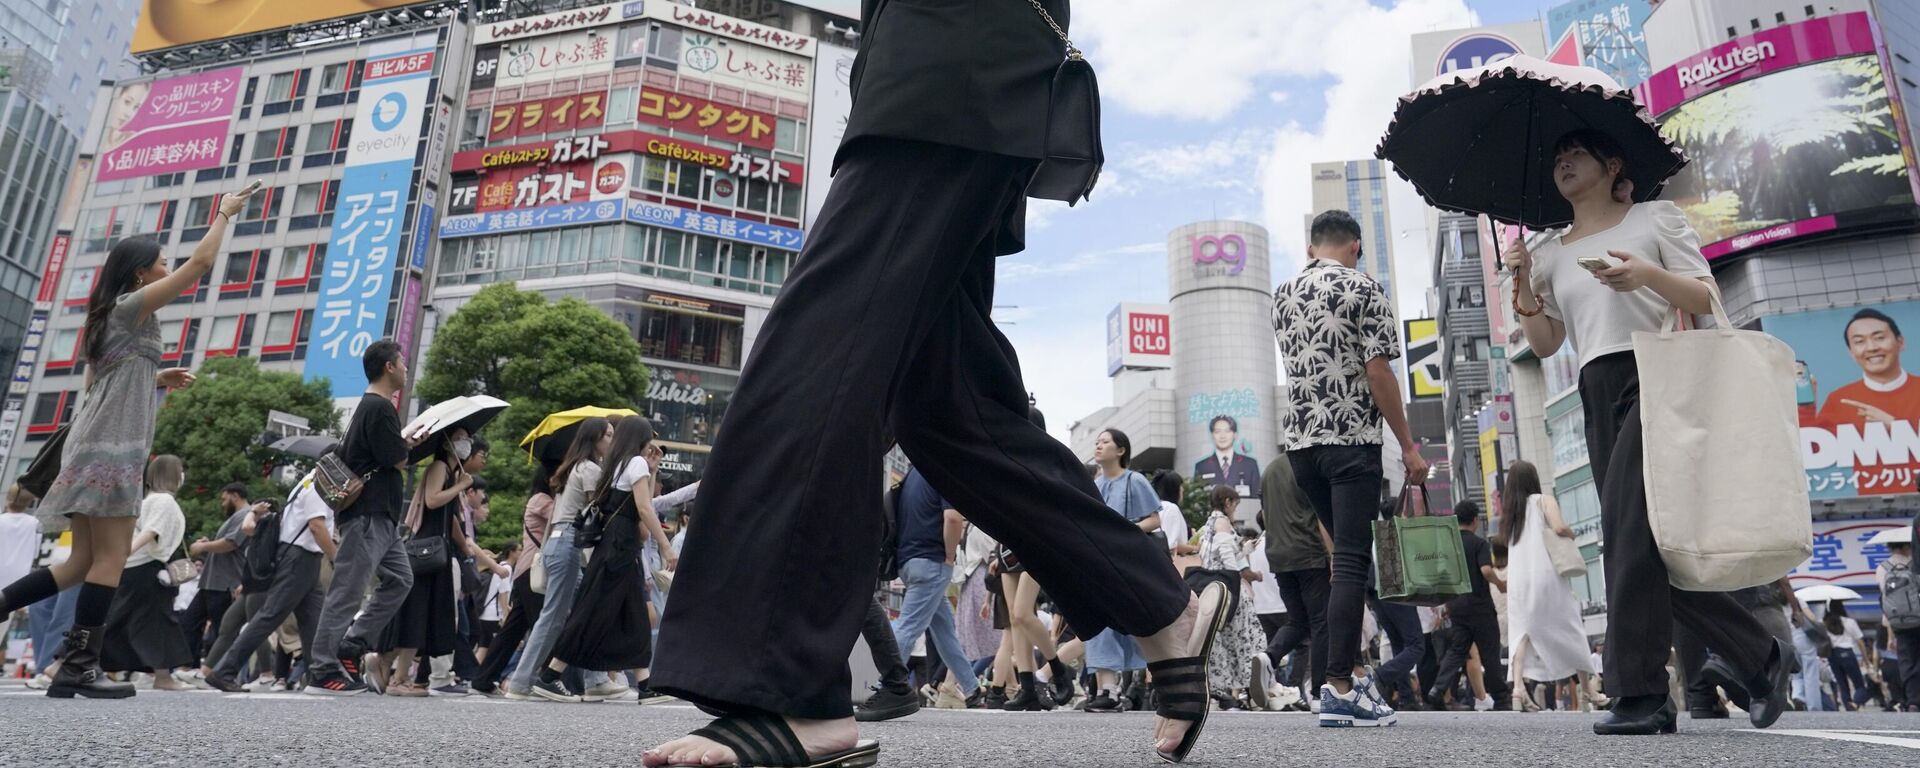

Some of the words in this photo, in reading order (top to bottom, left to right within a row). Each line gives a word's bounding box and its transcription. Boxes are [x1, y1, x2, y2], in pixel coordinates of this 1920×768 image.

[491, 6, 612, 39] しゃぶしゃぶバイキング
[673, 5, 808, 50] しゃぶしゃぶバイキング
[370, 54, 428, 77] 当ビル5F
[539, 36, 608, 68] しゃぶ葉
[1677, 40, 1776, 88] Rakuten
[475, 58, 498, 76] 9F
[726, 48, 806, 87] しゃぶ葉
[169, 78, 235, 102] 品川スキン
[165, 96, 224, 119] クリニック
[493, 95, 603, 133] プライス
[639, 90, 771, 139] コンタクト
[114, 136, 219, 171] 品川美容外科
[356, 133, 411, 155] eyecity
[551, 135, 609, 163] ガスト
[598, 174, 624, 187] ガスト
[728, 152, 790, 183] ガスト
[452, 186, 478, 207] 7F
[483, 181, 513, 199] Café
[514, 172, 586, 207] ガスト
[446, 218, 478, 231] AEON
[488, 205, 592, 232] 英会話イーオン
[633, 203, 674, 222] AEON
[683, 210, 801, 246] 英会話イーオン
[1731, 234, 1765, 248] Rakuten
[1764, 226, 1791, 241] Vision
[319, 192, 374, 360] アイシティ
[348, 189, 399, 358] コンタクトの
[1132, 317, 1163, 334] UNI
[1133, 334, 1167, 352] QLO
[657, 460, 694, 473] CCITANE
[660, 452, 679, 463] AFÉ
